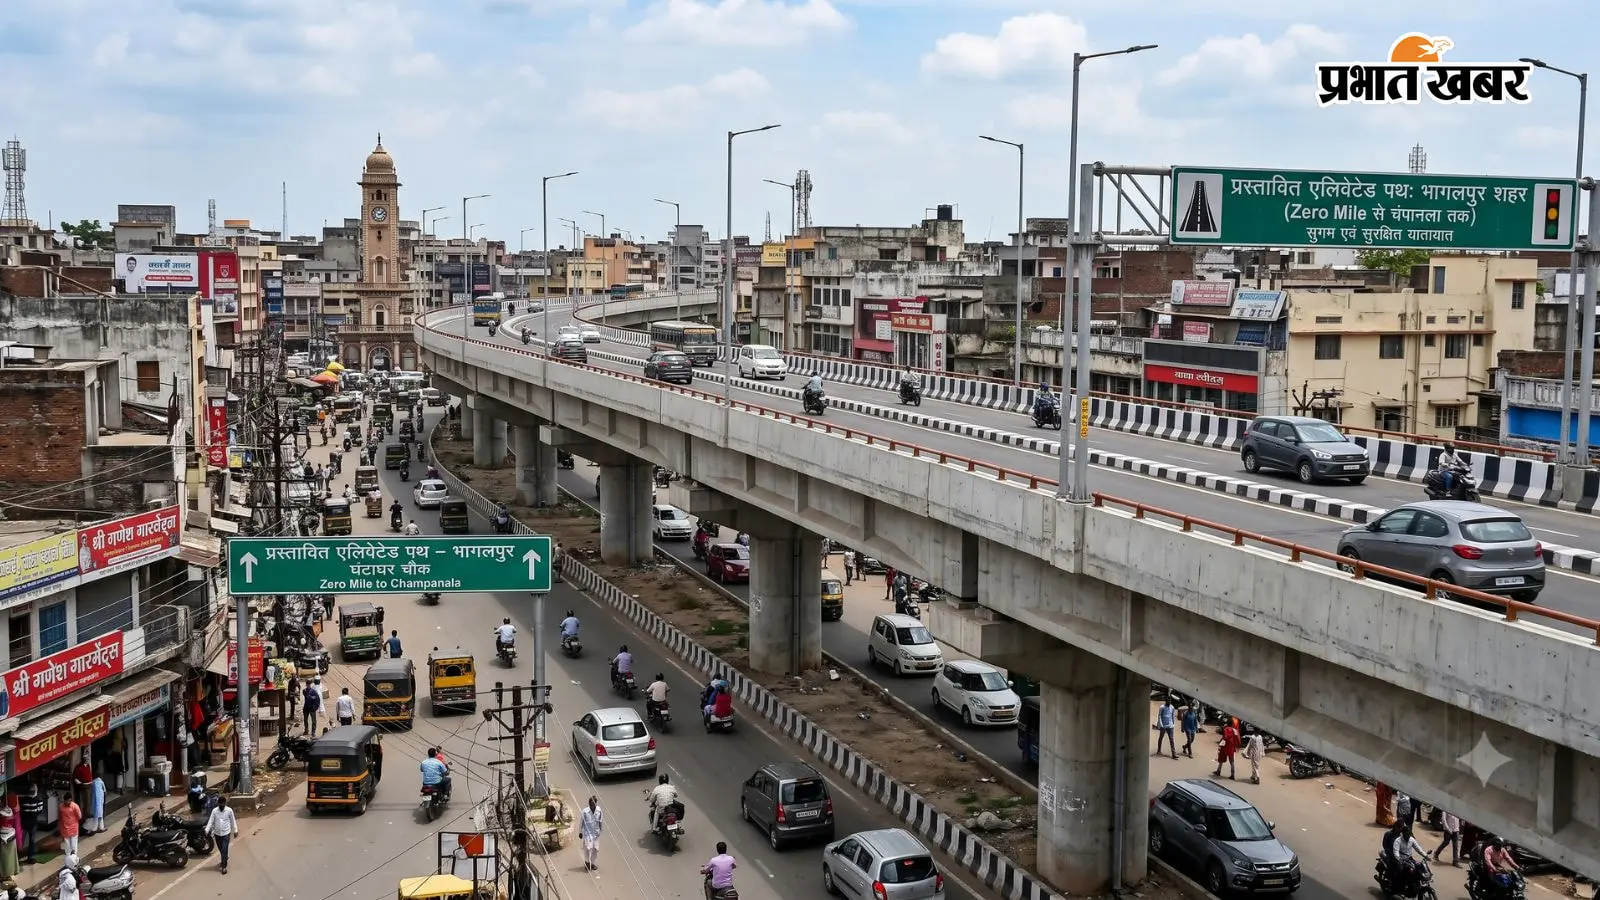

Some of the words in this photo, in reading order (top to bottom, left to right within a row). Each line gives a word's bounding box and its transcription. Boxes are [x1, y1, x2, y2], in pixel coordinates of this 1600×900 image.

[1231, 174, 1302, 197] प्रस्तावित
[1308, 176, 1377, 200] एलिवेटेड
[1421, 184, 1487, 207] भागलपुर
[1493, 186, 1528, 204] शहर
[1284, 202, 1329, 223] (Zero
[1334, 204, 1367, 221] Mile
[1372, 203, 1385, 221] से
[1390, 204, 1442, 222] चंपानला
[1447, 207, 1476, 227] तक)
[1306, 227, 1336, 243] सुगम
[1340, 225, 1357, 241] एवं
[1362, 225, 1402, 244] सुरक्षित
[1407, 229, 1454, 242] यातायात
[92, 528, 106, 550] श्री
[107, 524, 134, 546] गणेश
[265, 542, 330, 560] प्रस्तावित
[336, 542, 399, 561] एलिवेटेड
[405, 546, 430, 559] पथ
[452, 545, 515, 563] भागलपुर
[349, 562, 395, 576] घंटाघर
[400, 560, 431, 575] चौक
[320, 579, 346, 589] Zero
[349, 578, 373, 589] Mile
[376, 579, 387, 589] to
[390, 578, 461, 590] Champanala
[12, 669, 30, 698] श्री
[32, 660, 68, 689] गणेश
[70, 641, 120, 674] गारमेंट्स
[19, 733, 58, 762] पटना
[61, 716, 106, 745] स्वीट्स
